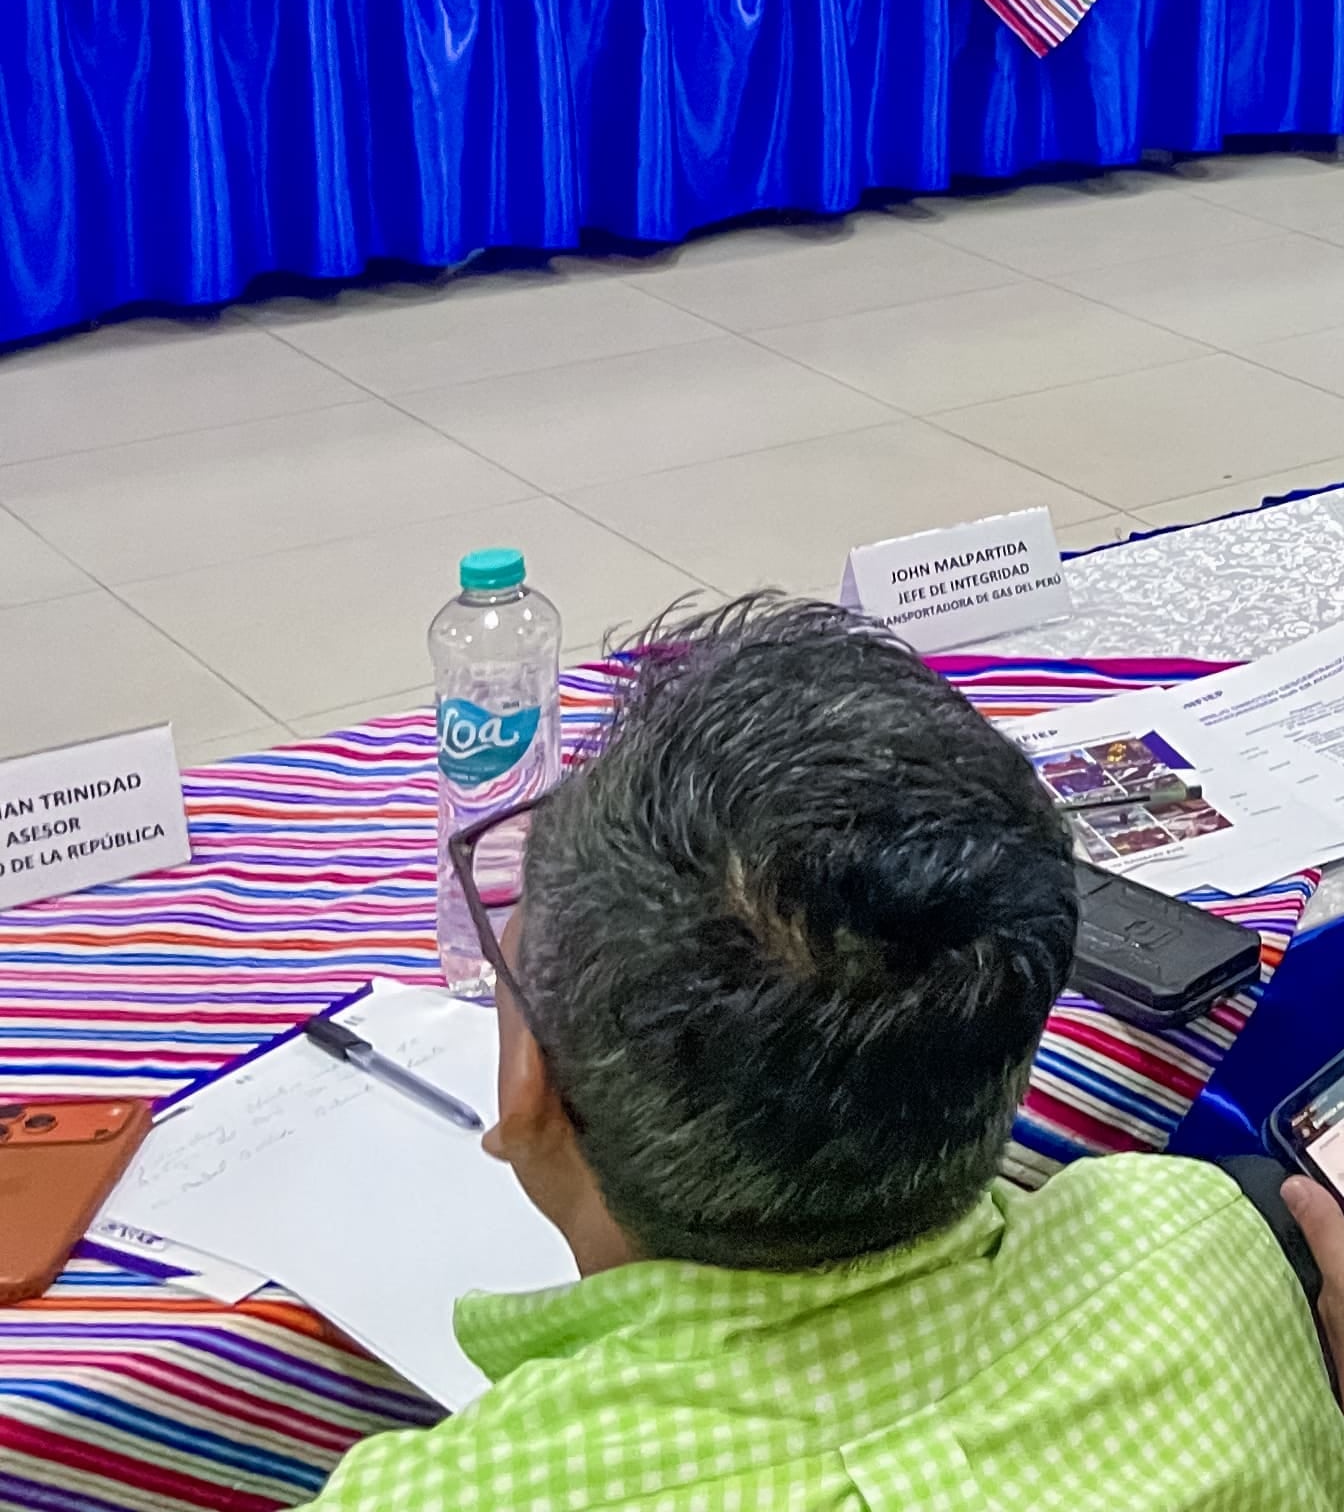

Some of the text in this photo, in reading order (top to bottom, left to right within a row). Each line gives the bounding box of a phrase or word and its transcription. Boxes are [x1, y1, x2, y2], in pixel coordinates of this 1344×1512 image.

[891, 541, 1027, 584] JOHN MALPARTIDA
[899, 563, 1030, 605] JEFE DE INTEGRIDAD
[976, 592, 989, 604] DE
[992, 586, 1013, 600] GAS
[1015, 582, 1034, 595] DEL
[1036, 574, 1062, 590] PERÚ
[39, 772, 142, 810] TRINIDAD
[6, 817, 81, 848] ASESOR
[11, 855, 35, 874] DE
[40, 849, 63, 866] LA
[67, 823, 165, 861] REPÚBLICA
